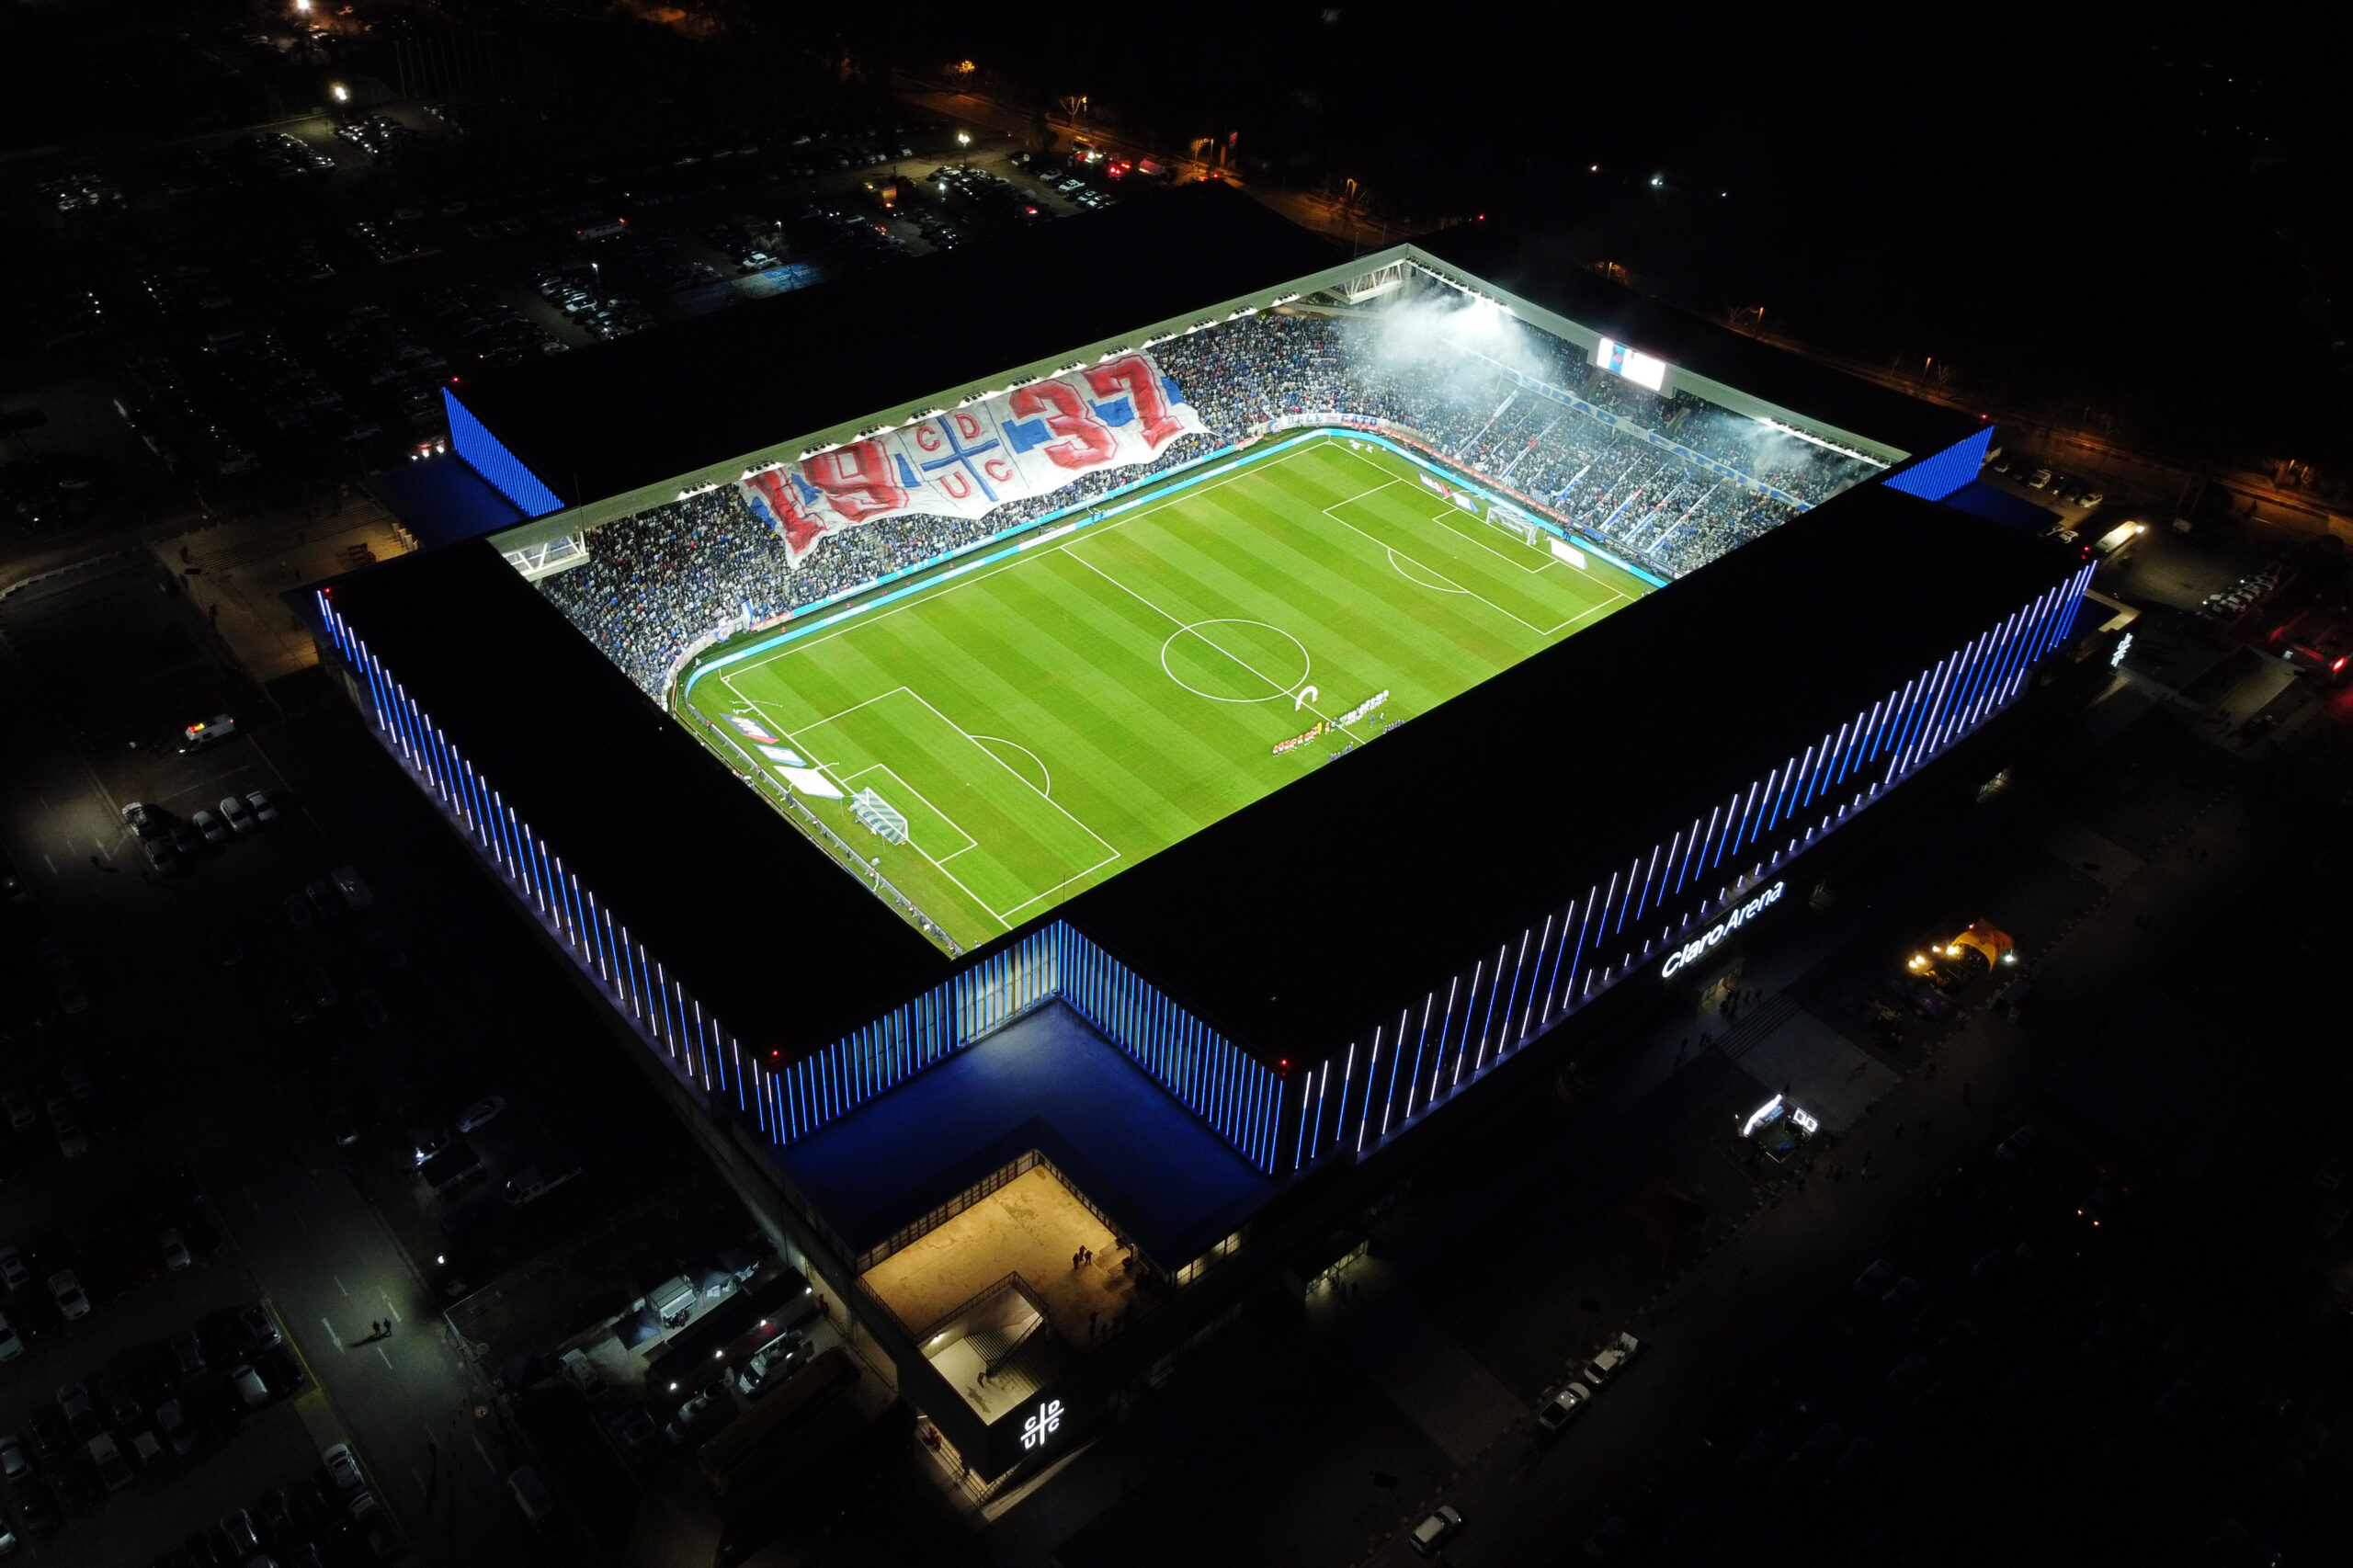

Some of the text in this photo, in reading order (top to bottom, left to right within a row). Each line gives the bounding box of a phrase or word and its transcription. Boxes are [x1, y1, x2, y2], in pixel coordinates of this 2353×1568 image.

[1008, 354, 1185, 471] 37
[1341, 414, 1378, 426] CATO
[1661, 881, 1786, 979] Claro Arena
